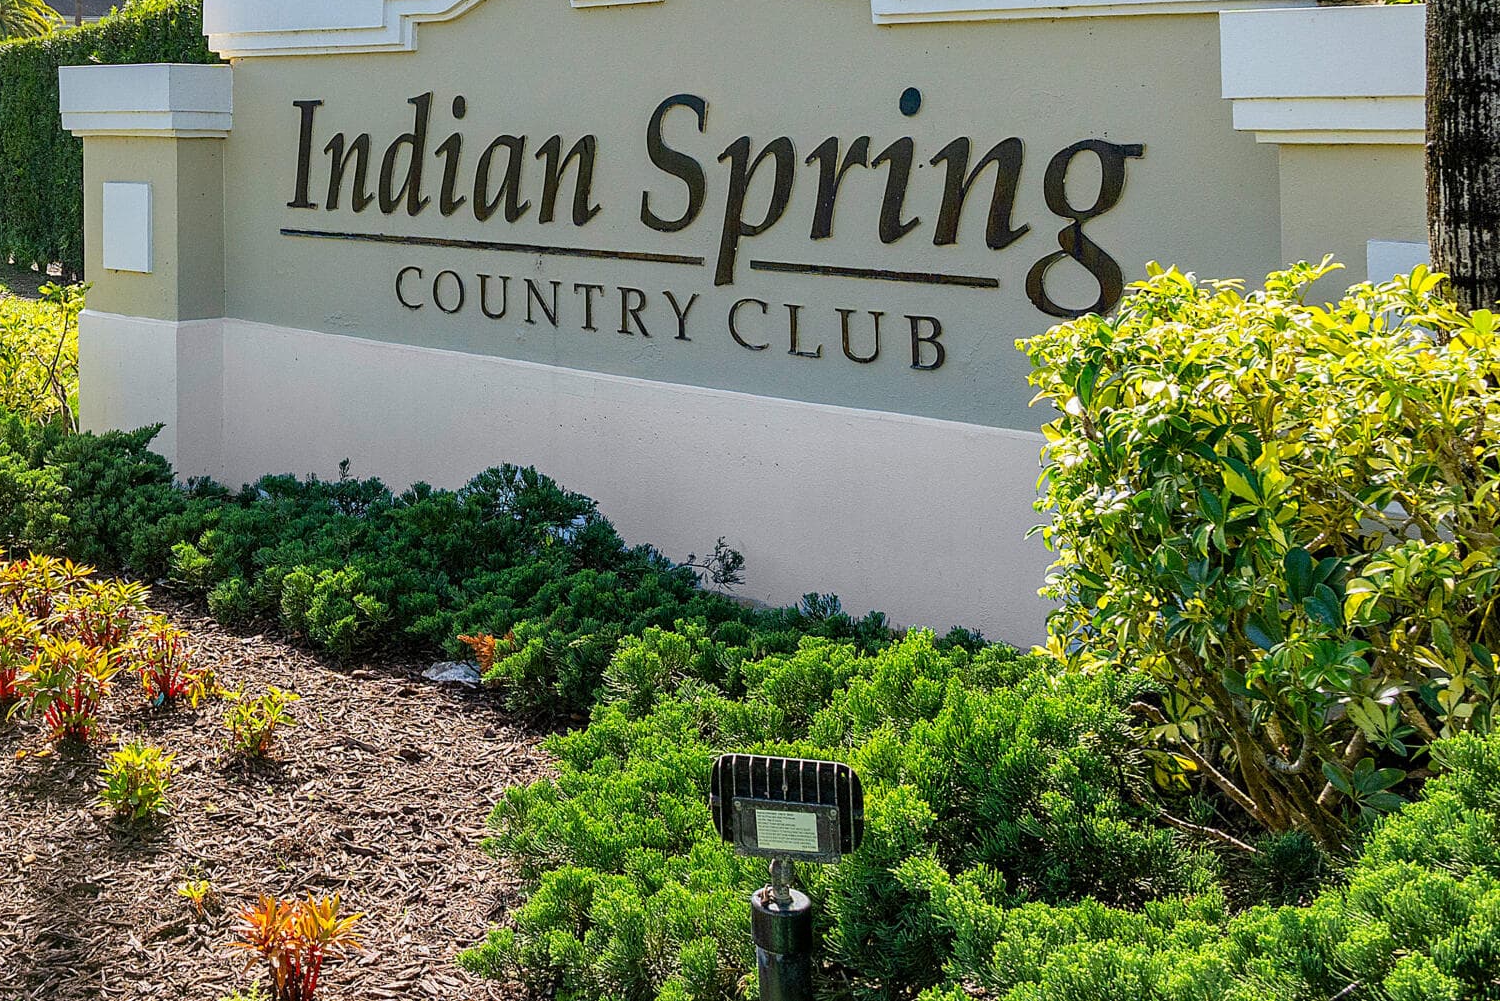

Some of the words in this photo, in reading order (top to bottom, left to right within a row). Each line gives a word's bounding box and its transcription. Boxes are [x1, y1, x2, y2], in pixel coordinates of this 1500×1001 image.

[286, 91, 602, 227] Indian
[640, 87, 1145, 318] Spring
[395, 265, 700, 341] COUNTRY
[727, 298, 946, 371] CLUB
